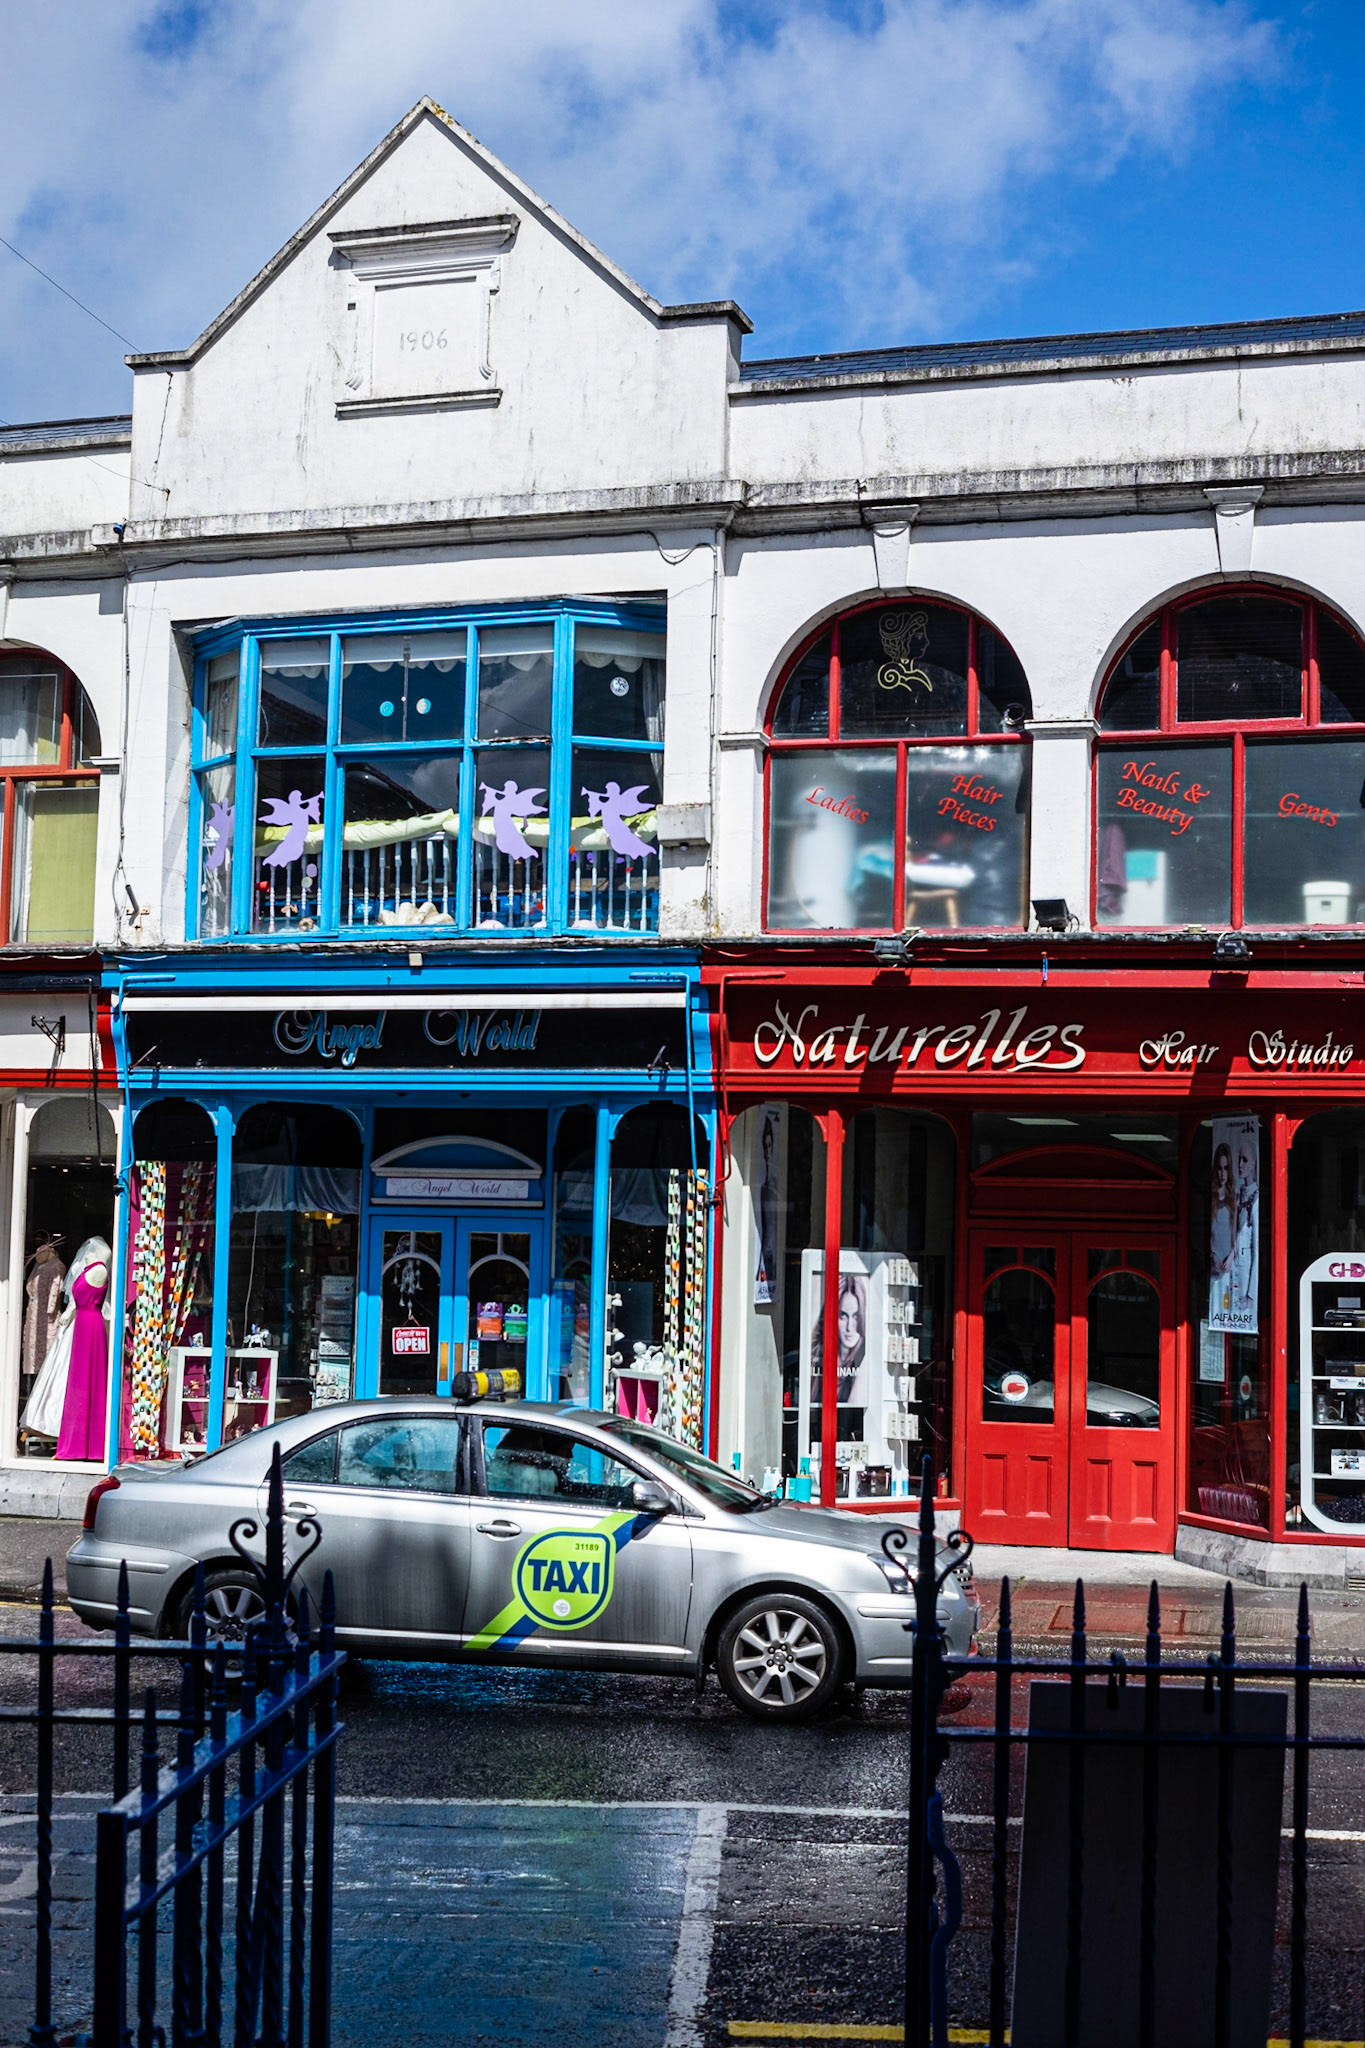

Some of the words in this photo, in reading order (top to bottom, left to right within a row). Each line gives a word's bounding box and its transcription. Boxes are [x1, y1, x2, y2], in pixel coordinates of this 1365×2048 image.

[400, 328, 448, 352] 1906
[952, 773, 1003, 806] Hair
[1122, 761, 1180, 795] Nails
[1184, 783, 1210, 804] &
[805, 786, 869, 825] Ladies
[937, 797, 998, 832] Pieces
[1116, 787, 1194, 836] Beauty
[1278, 792, 1340, 827] Gents
[272, 1009, 387, 1067] Angel
[422, 1009, 542, 1056] World
[754, 999, 1086, 1072] Naturelles
[1139, 1030, 1219, 1064] Hair
[1248, 1029, 1354, 1065] Studio
[411, 1180, 452, 1194] Angel
[458, 1179, 502, 1194] World
[1213, 1313, 1253, 1324] ALFAPARF
[396, 1337, 427, 1352] OPEN
[575, 1543, 600, 1552] 31189
[527, 1559, 601, 1595] TAXI
